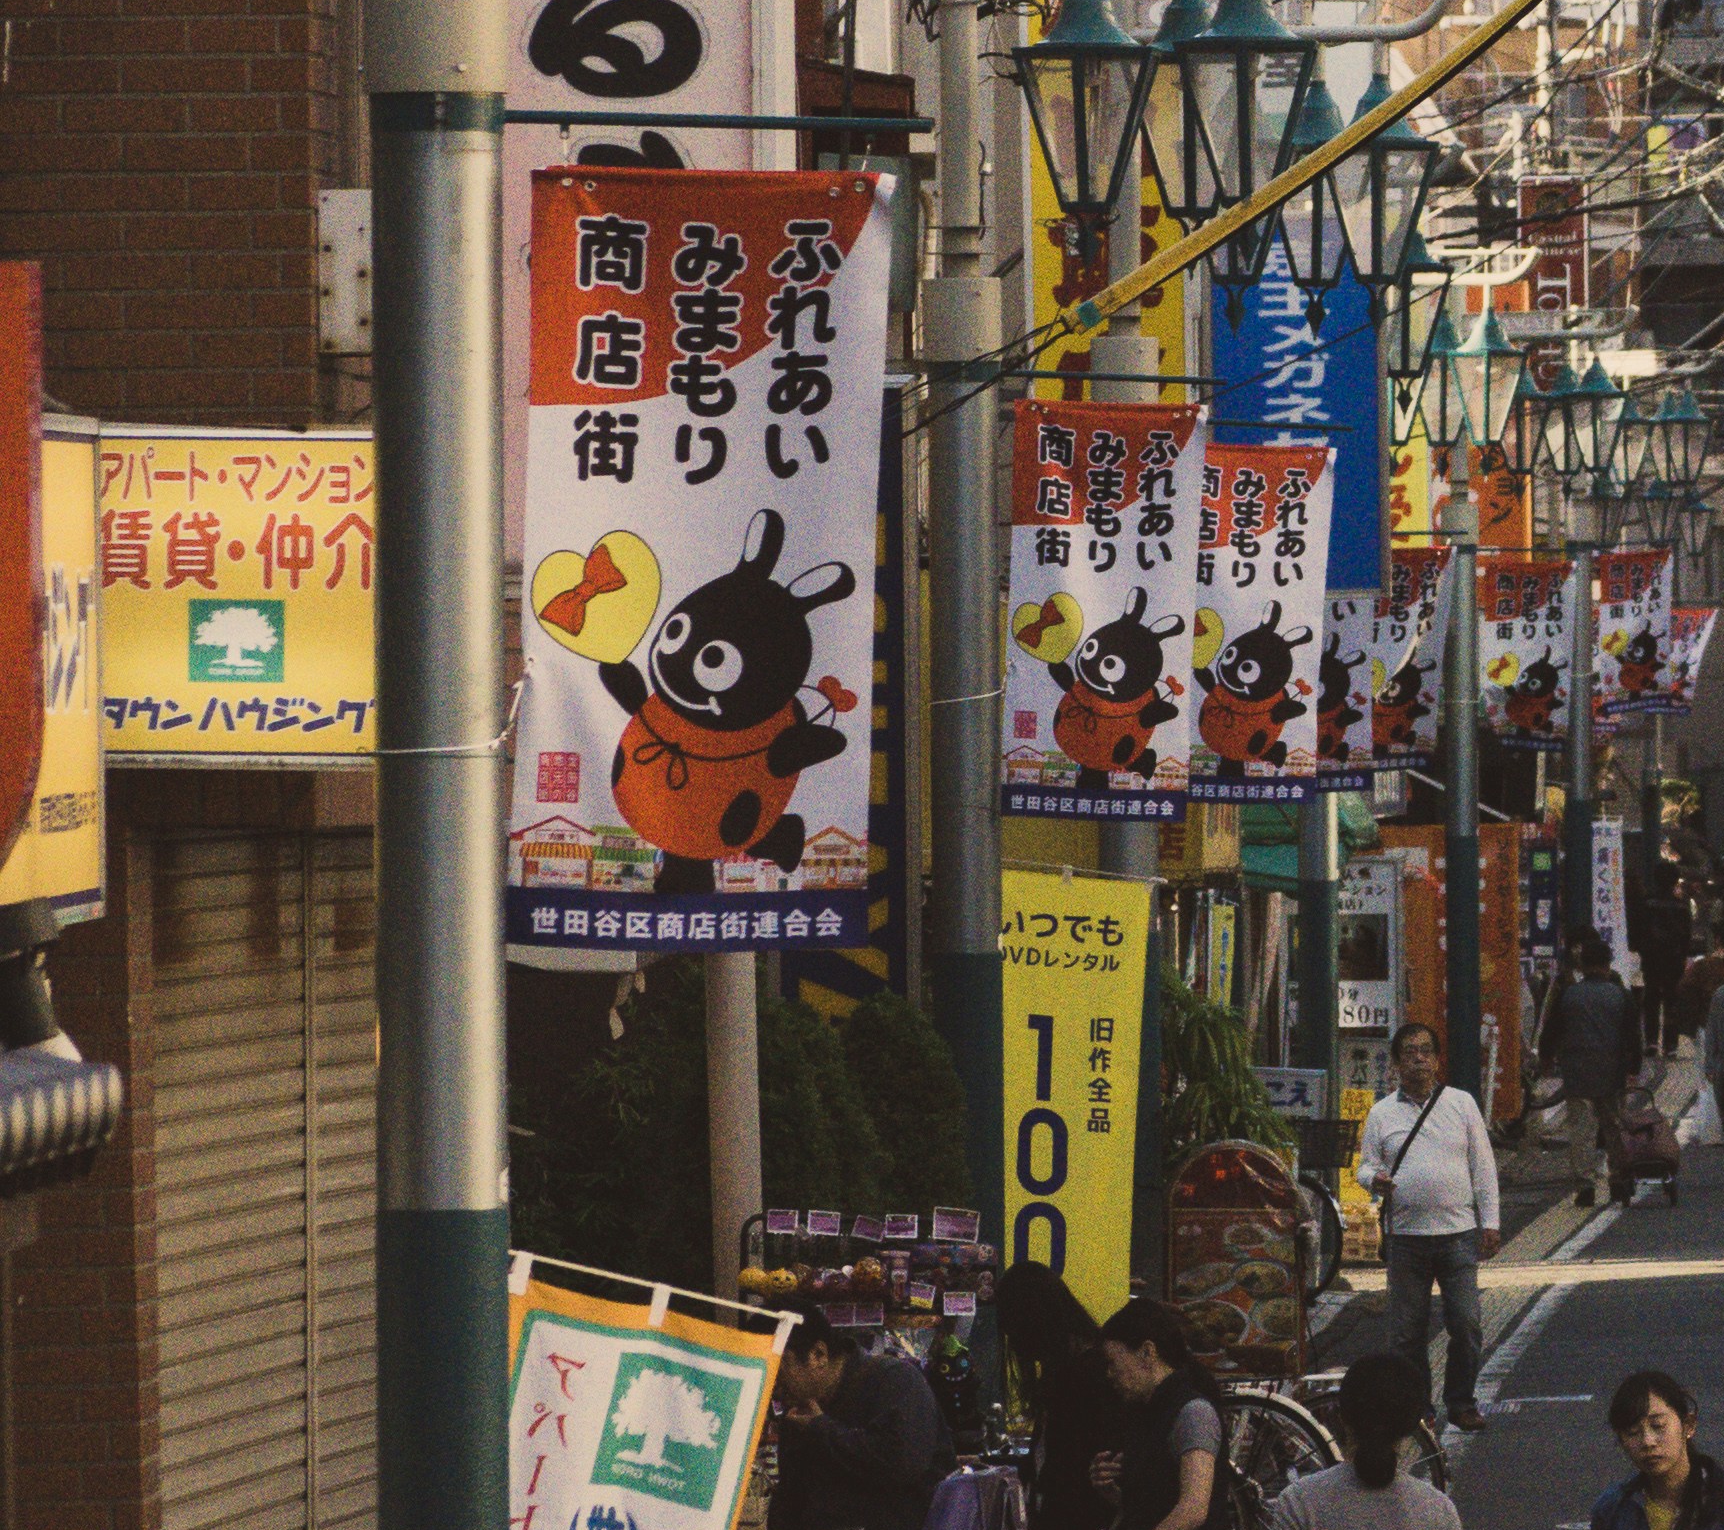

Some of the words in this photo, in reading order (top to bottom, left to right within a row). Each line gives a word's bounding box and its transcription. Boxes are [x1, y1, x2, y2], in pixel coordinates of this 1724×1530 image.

[573, 214, 650, 485] 商店街
[668, 222, 747, 486] みまもり
[764, 219, 845, 479] ふれあい
[101, 508, 374, 591] 賃貸・仲介
[1035, 424, 1077, 568] 商店街
[1085, 430, 1128, 574] みまもり
[1136, 429, 1180, 571] ふれあい
[1229, 469, 1268, 588] みまもり
[1272, 469, 1313, 588] ふれあい
[1011, 794, 1175, 817] 世田谷区商店街連合会
[531, 906, 843, 941] 世田谷区商店街連合会
[1002, 910, 1124, 946] いつでも
[1087, 1017, 1115, 1134] 旧作全品
